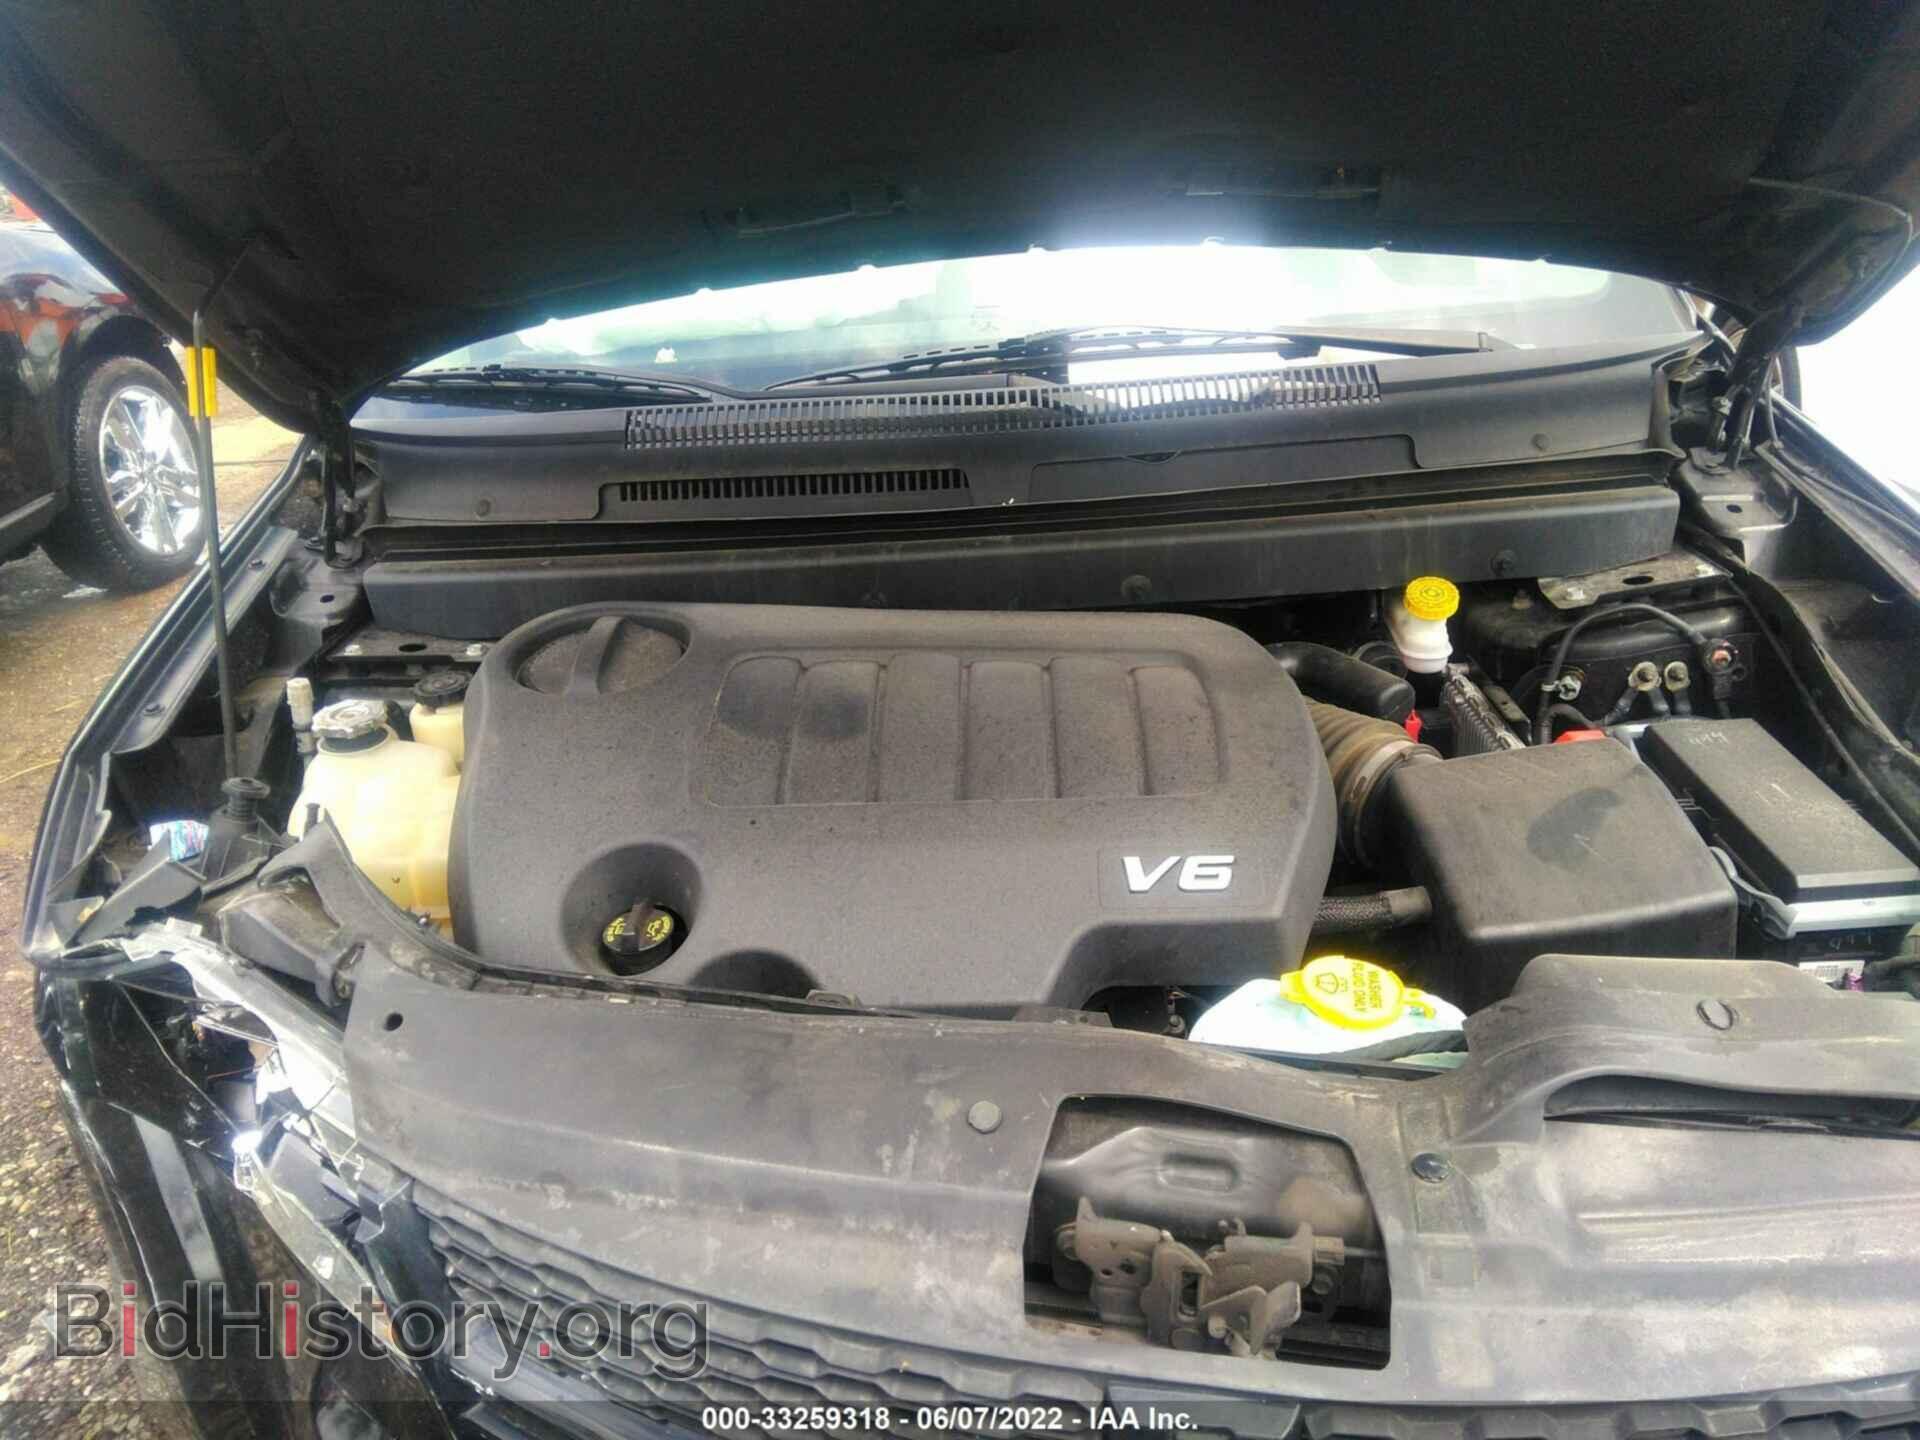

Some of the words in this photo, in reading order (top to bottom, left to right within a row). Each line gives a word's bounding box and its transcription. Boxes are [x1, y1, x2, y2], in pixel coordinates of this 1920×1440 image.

[1122, 855, 1235, 892] V6
[1352, 962, 1366, 988] FLUID
[1367, 971, 1383, 1009] WASHER
